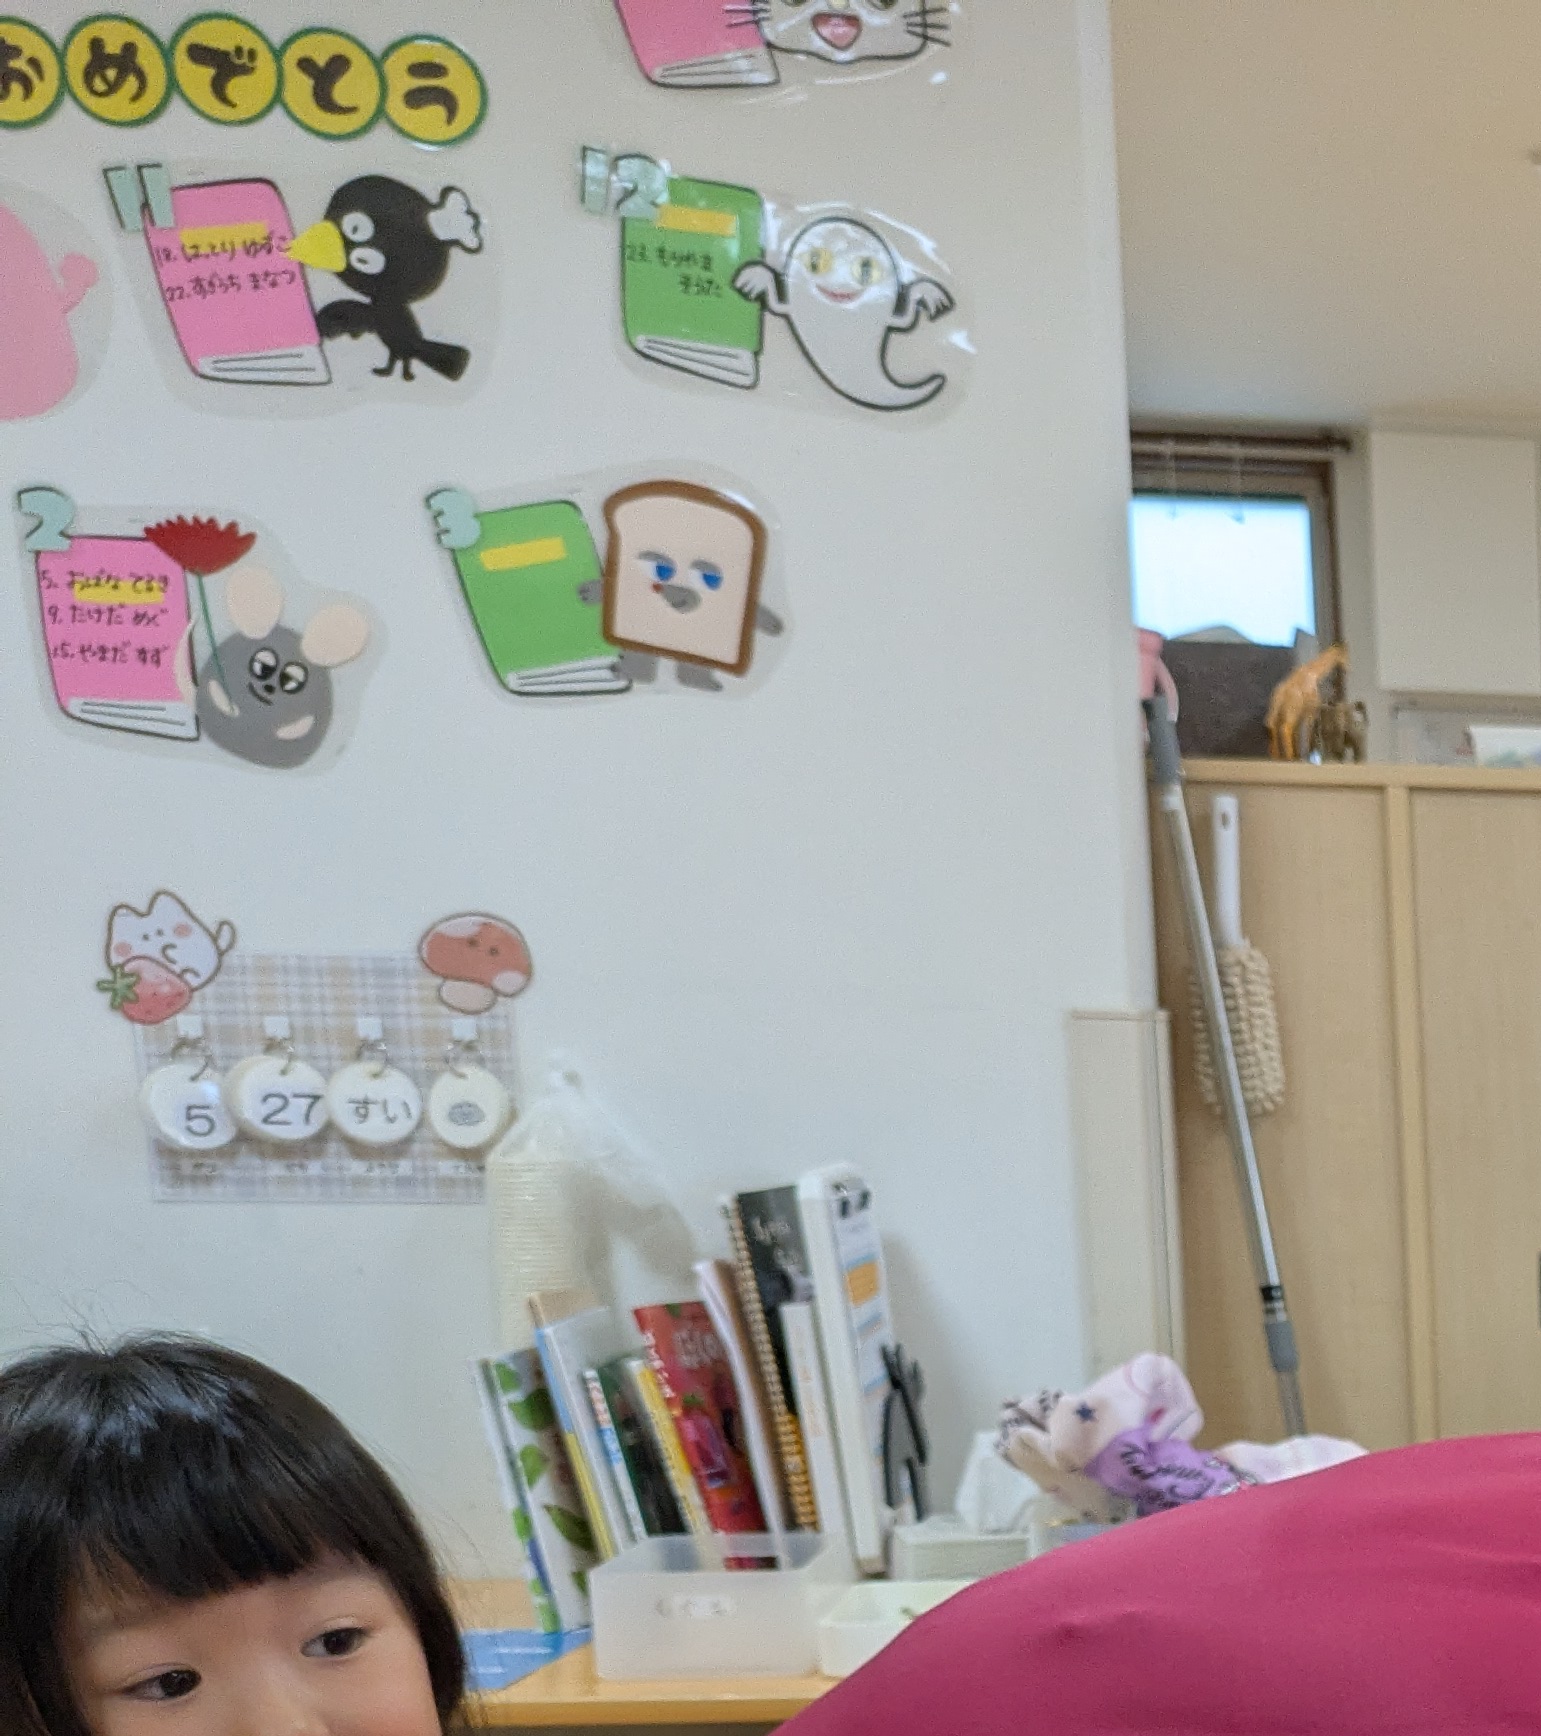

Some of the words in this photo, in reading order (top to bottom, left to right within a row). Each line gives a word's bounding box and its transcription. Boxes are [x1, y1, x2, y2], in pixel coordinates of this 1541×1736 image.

[185, 1104, 216, 1137] 5
[261, 1092, 326, 1125] 27
[347, 1094, 413, 1124] すい
